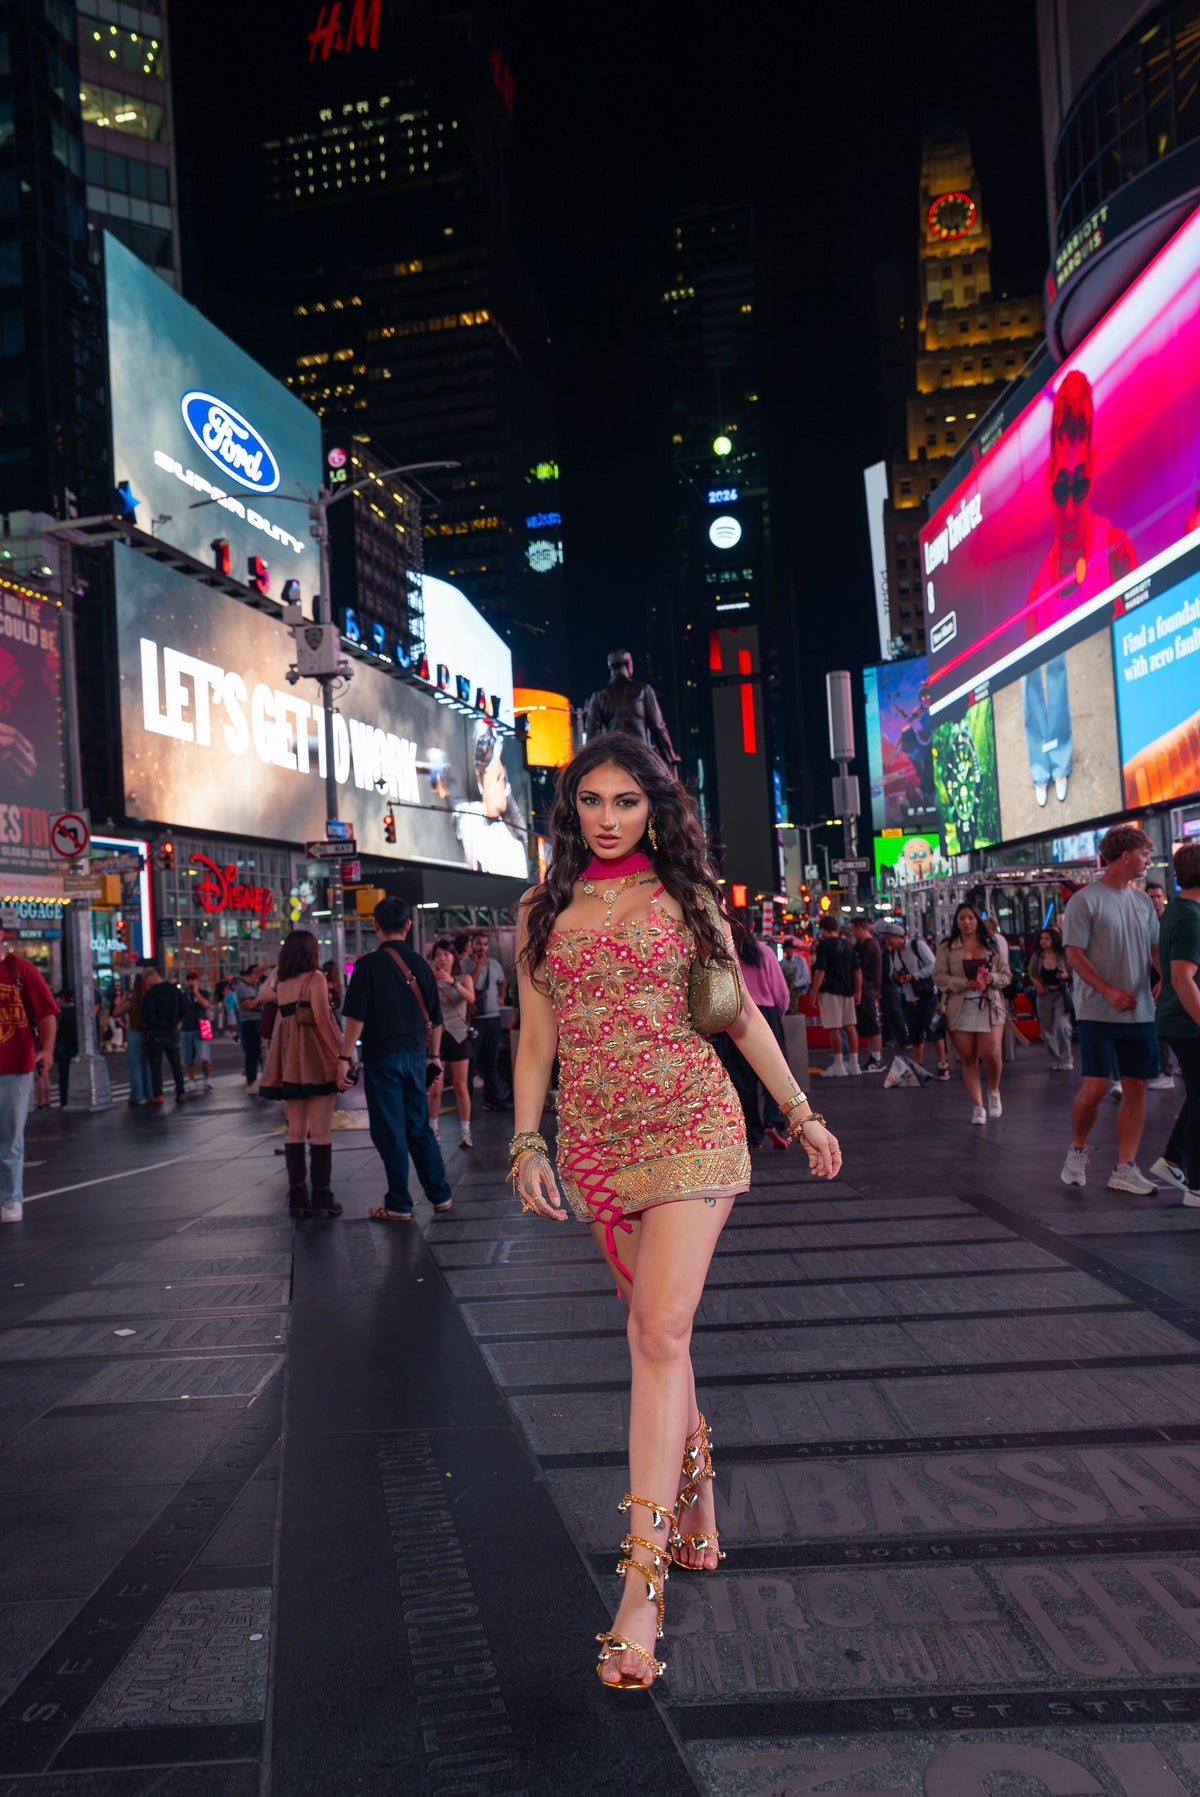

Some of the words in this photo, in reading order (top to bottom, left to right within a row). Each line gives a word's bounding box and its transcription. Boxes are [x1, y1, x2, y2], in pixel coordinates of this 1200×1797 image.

[202, 405, 264, 482] Ford
[329, 468, 347, 483] LG
[153, 450, 246, 519] SUPER
[246, 508, 306, 554] DUTY
[1122, 624, 1147, 656] Find
[1147, 626, 1156, 643] a
[1124, 654, 1149, 683] with
[141, 637, 250, 757] LET'S
[251, 683, 312, 775] GET
[312, 704, 351, 785] TO
[349, 717, 421, 804] WORK
[844, 1545, 953, 1558] 50TH
[978, 1537, 1144, 1553] STREET
[892, 1703, 1012, 1720] 51ST
[1047, 1698, 1191, 1715] STRE
